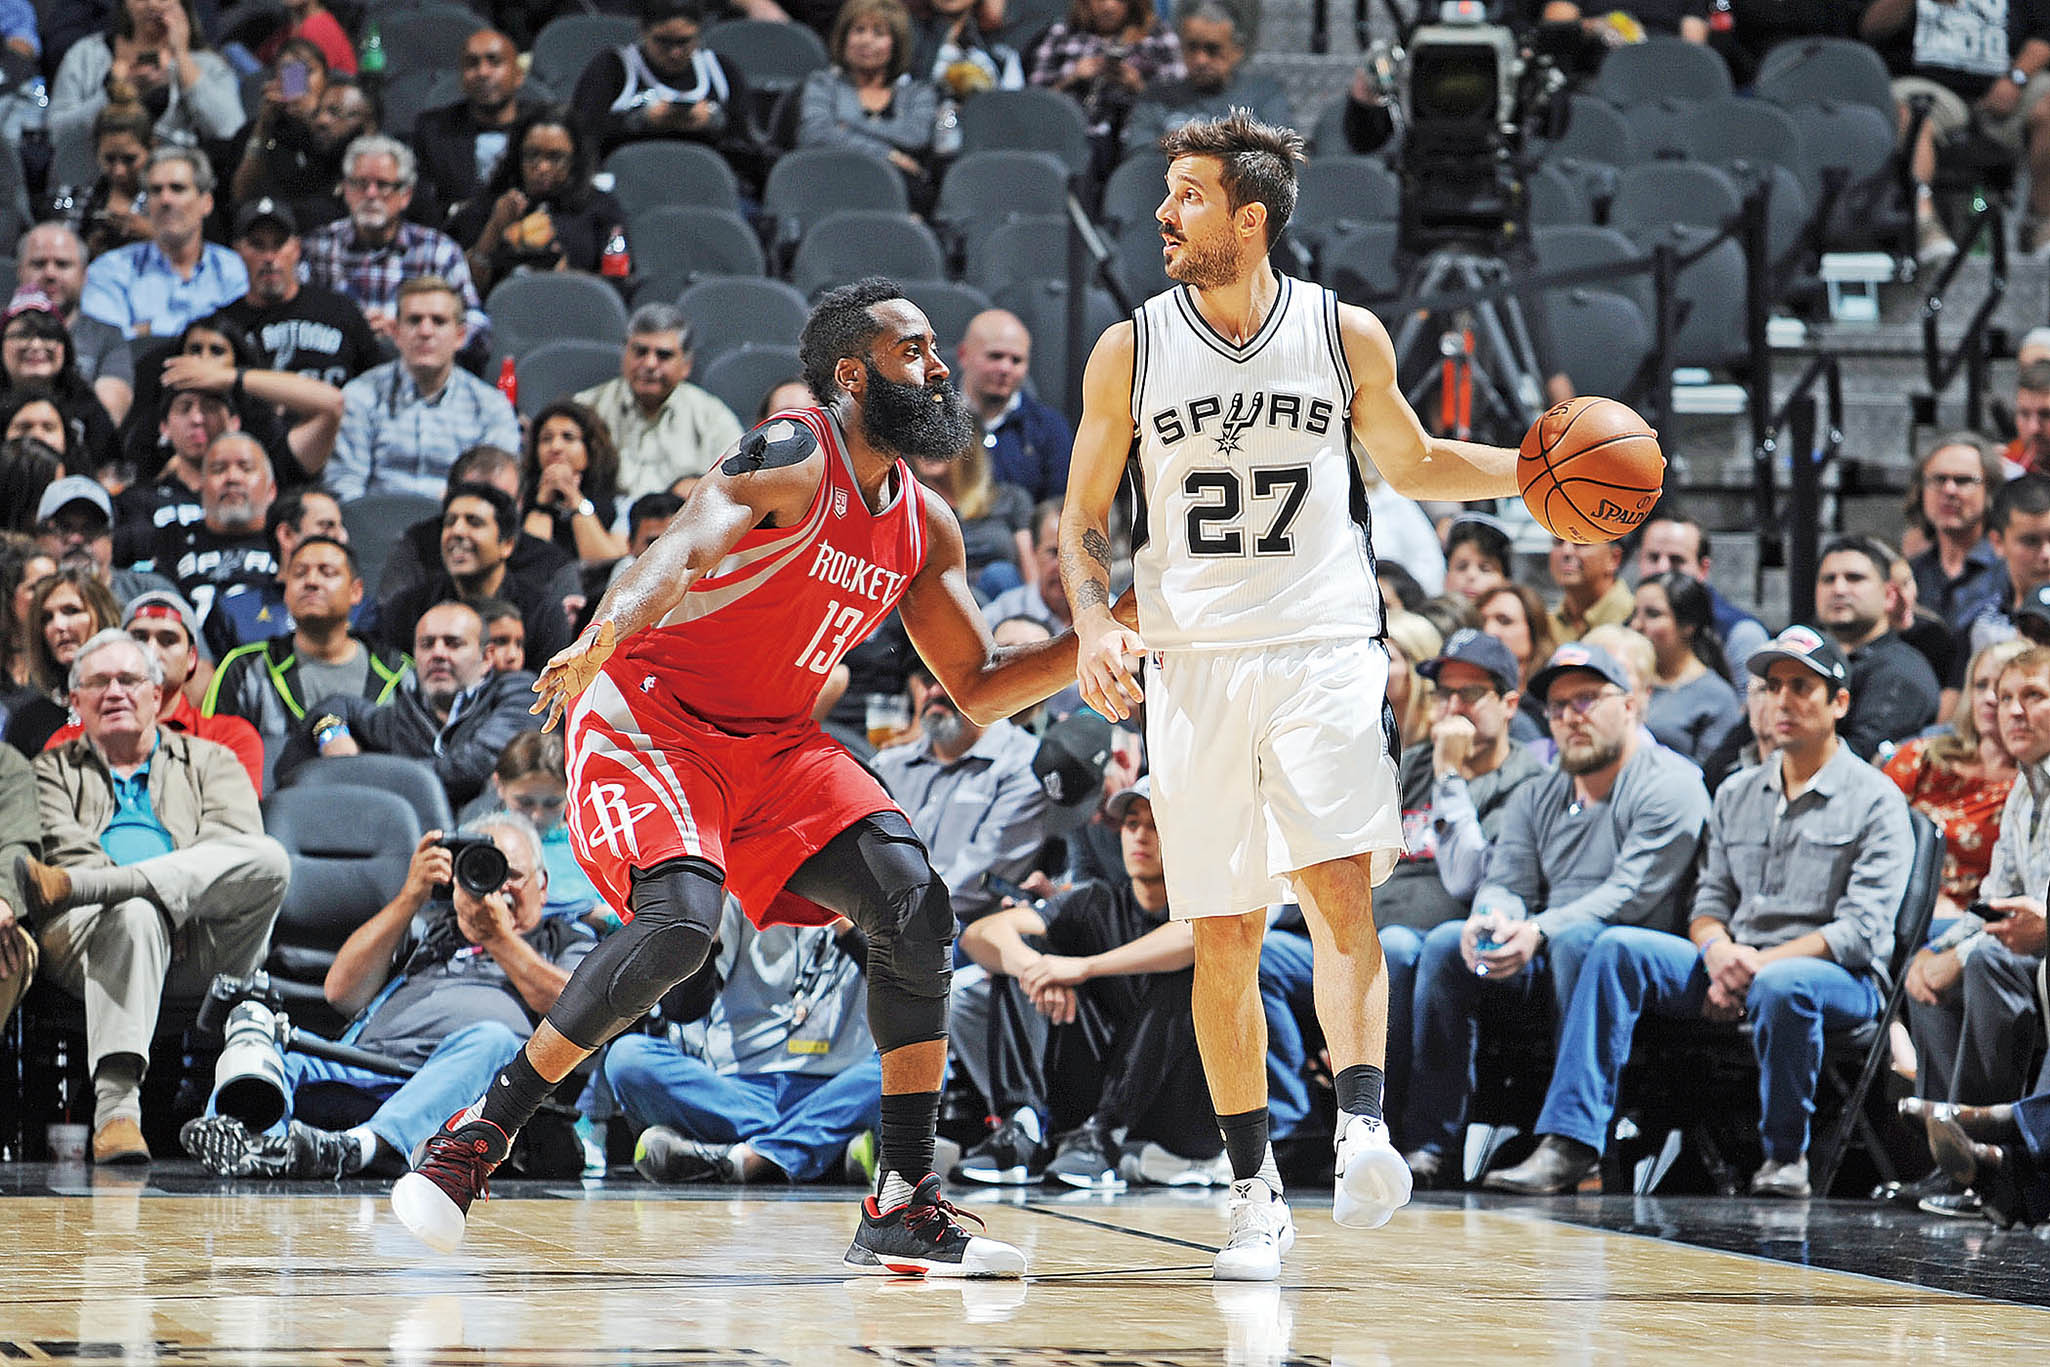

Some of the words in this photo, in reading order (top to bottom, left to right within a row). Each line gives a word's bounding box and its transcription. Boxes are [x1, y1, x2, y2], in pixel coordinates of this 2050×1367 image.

[1152, 391, 1335, 453] SPURS
[1181, 462, 1312, 558] 27
[794, 600, 864, 675] 13
